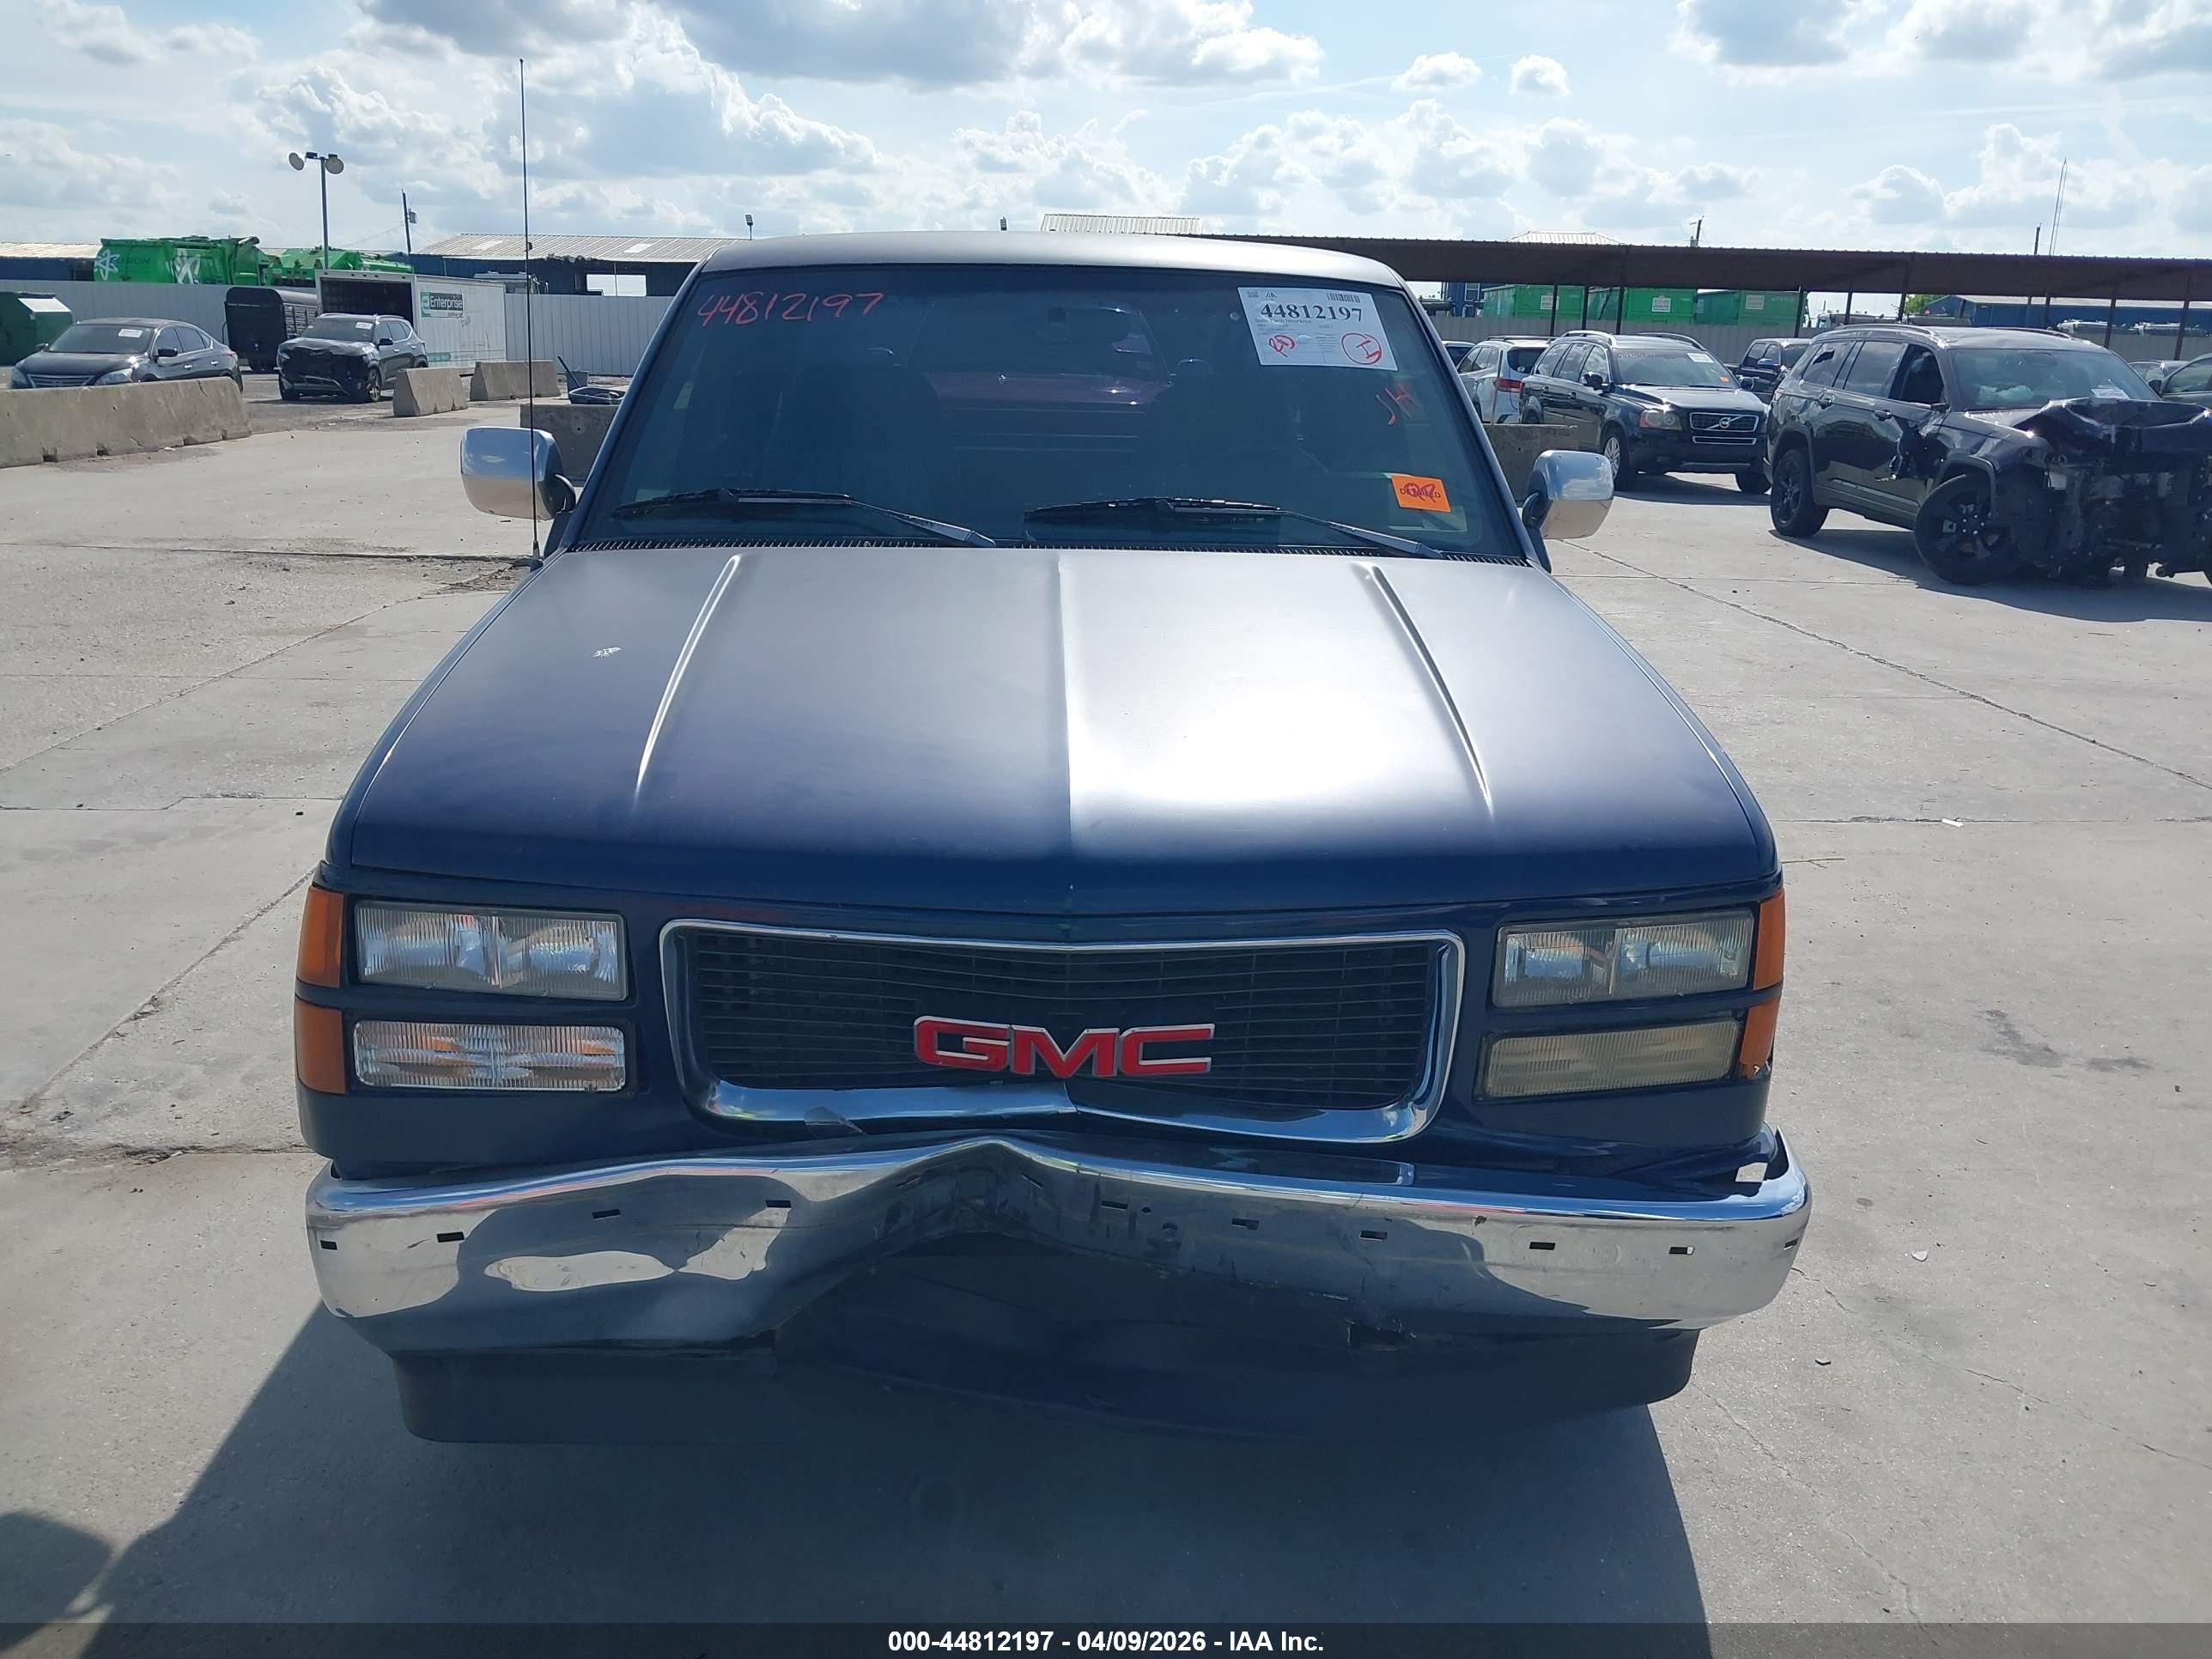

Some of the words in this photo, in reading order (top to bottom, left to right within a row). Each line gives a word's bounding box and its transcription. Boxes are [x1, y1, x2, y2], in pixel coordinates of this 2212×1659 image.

[430, 295, 463, 310] Enterprise
[697, 291, 884, 326] 44812197
[1261, 303, 1362, 322] 44812197
[914, 1015, 1215, 1079] GMC
